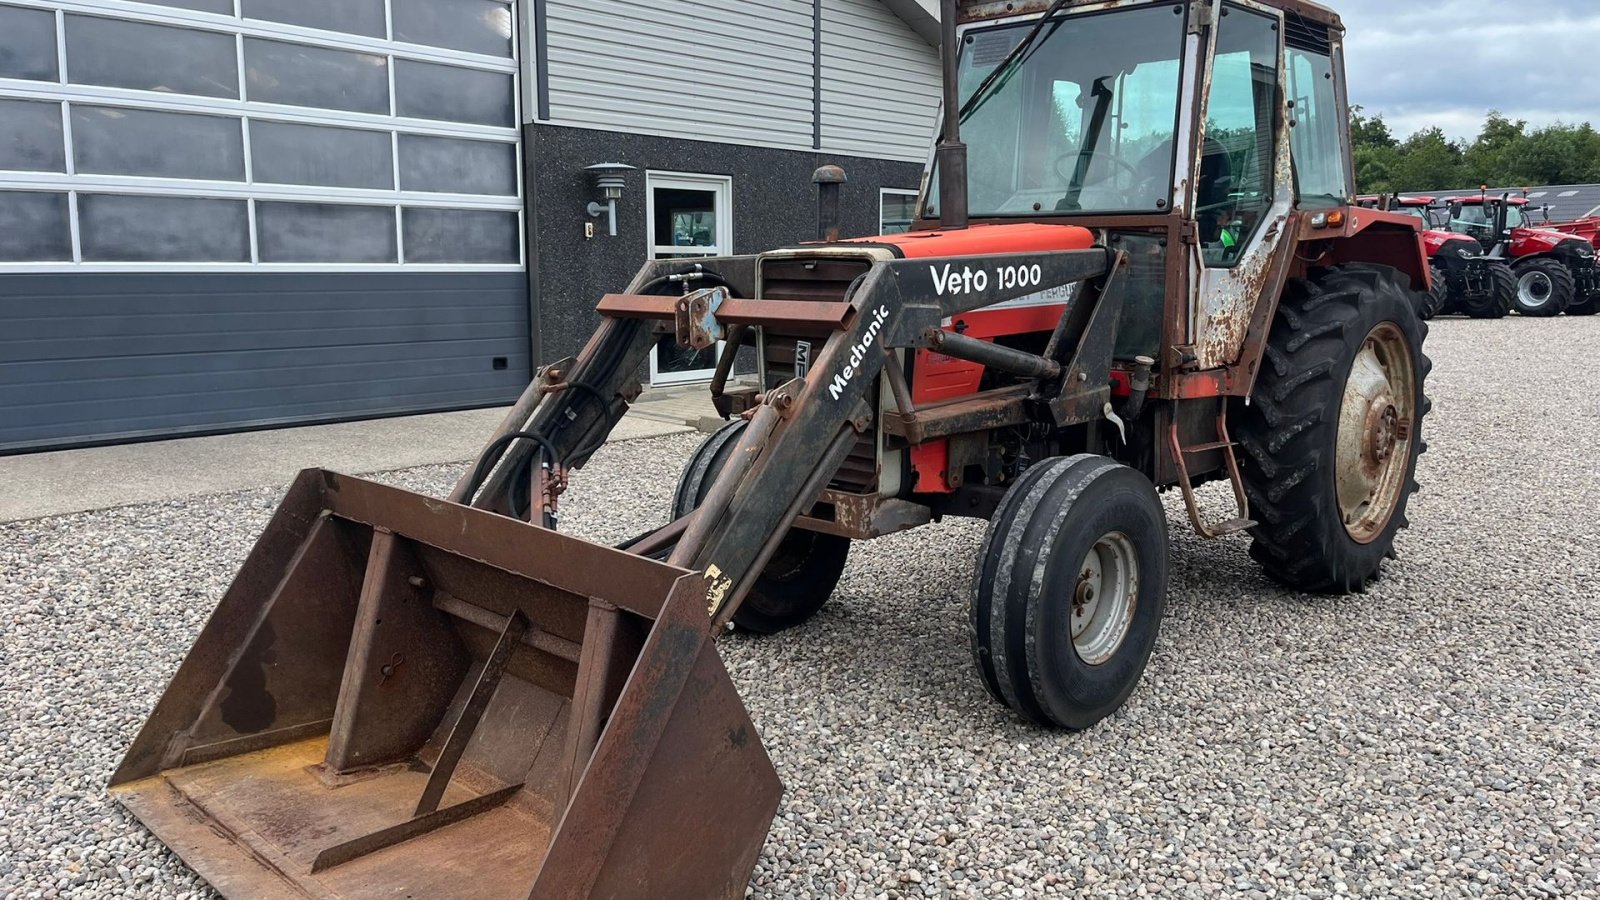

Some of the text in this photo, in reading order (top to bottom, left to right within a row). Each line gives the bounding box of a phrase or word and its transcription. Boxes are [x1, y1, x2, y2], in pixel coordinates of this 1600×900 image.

[930, 263, 1042, 296] Veto 1000
[828, 304, 889, 400] Mechanic
